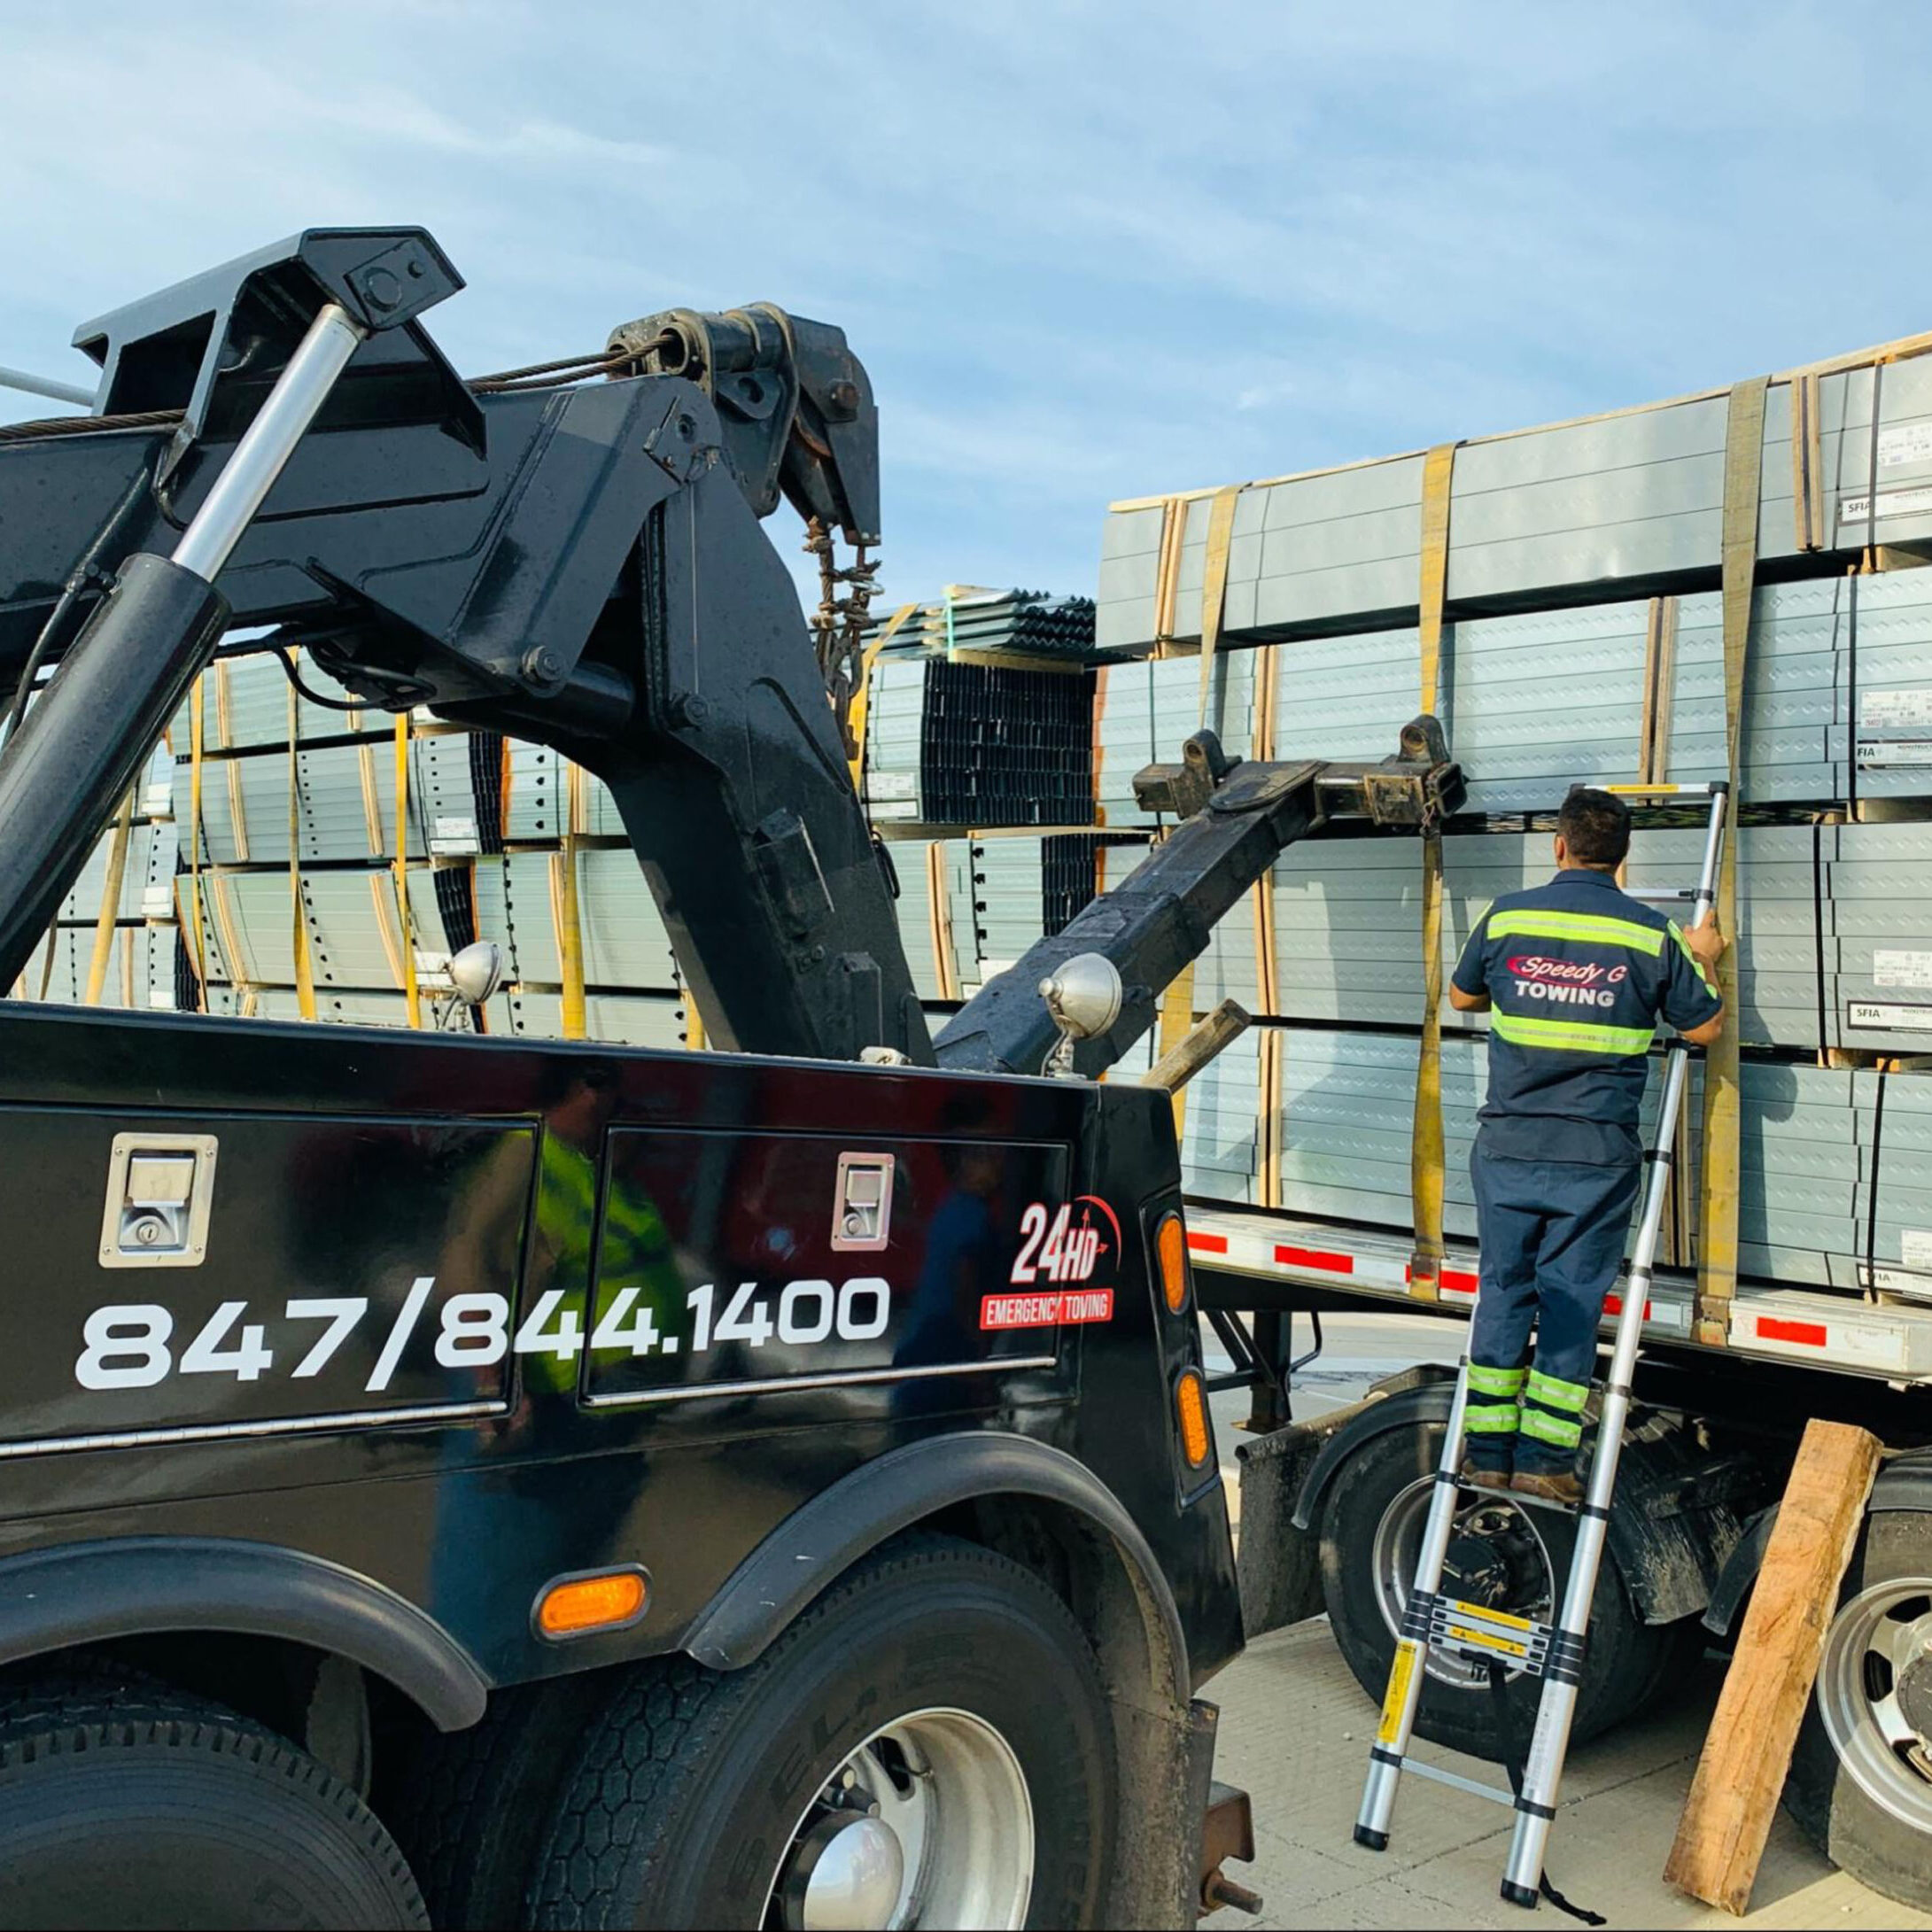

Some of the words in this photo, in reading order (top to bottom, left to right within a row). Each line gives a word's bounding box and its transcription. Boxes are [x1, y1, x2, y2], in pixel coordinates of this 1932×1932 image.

[1858, 748, 1875, 757] FIA
[1521, 957, 1605, 984] Speedy
[1608, 966, 1627, 982] G
[1515, 980, 1615, 1007] TOWING
[1857, 1009, 1881, 1018] SFIA
[986, 1296, 1062, 1325] EMERGENCY
[74, 1276, 890, 1390] 847/844.1400
